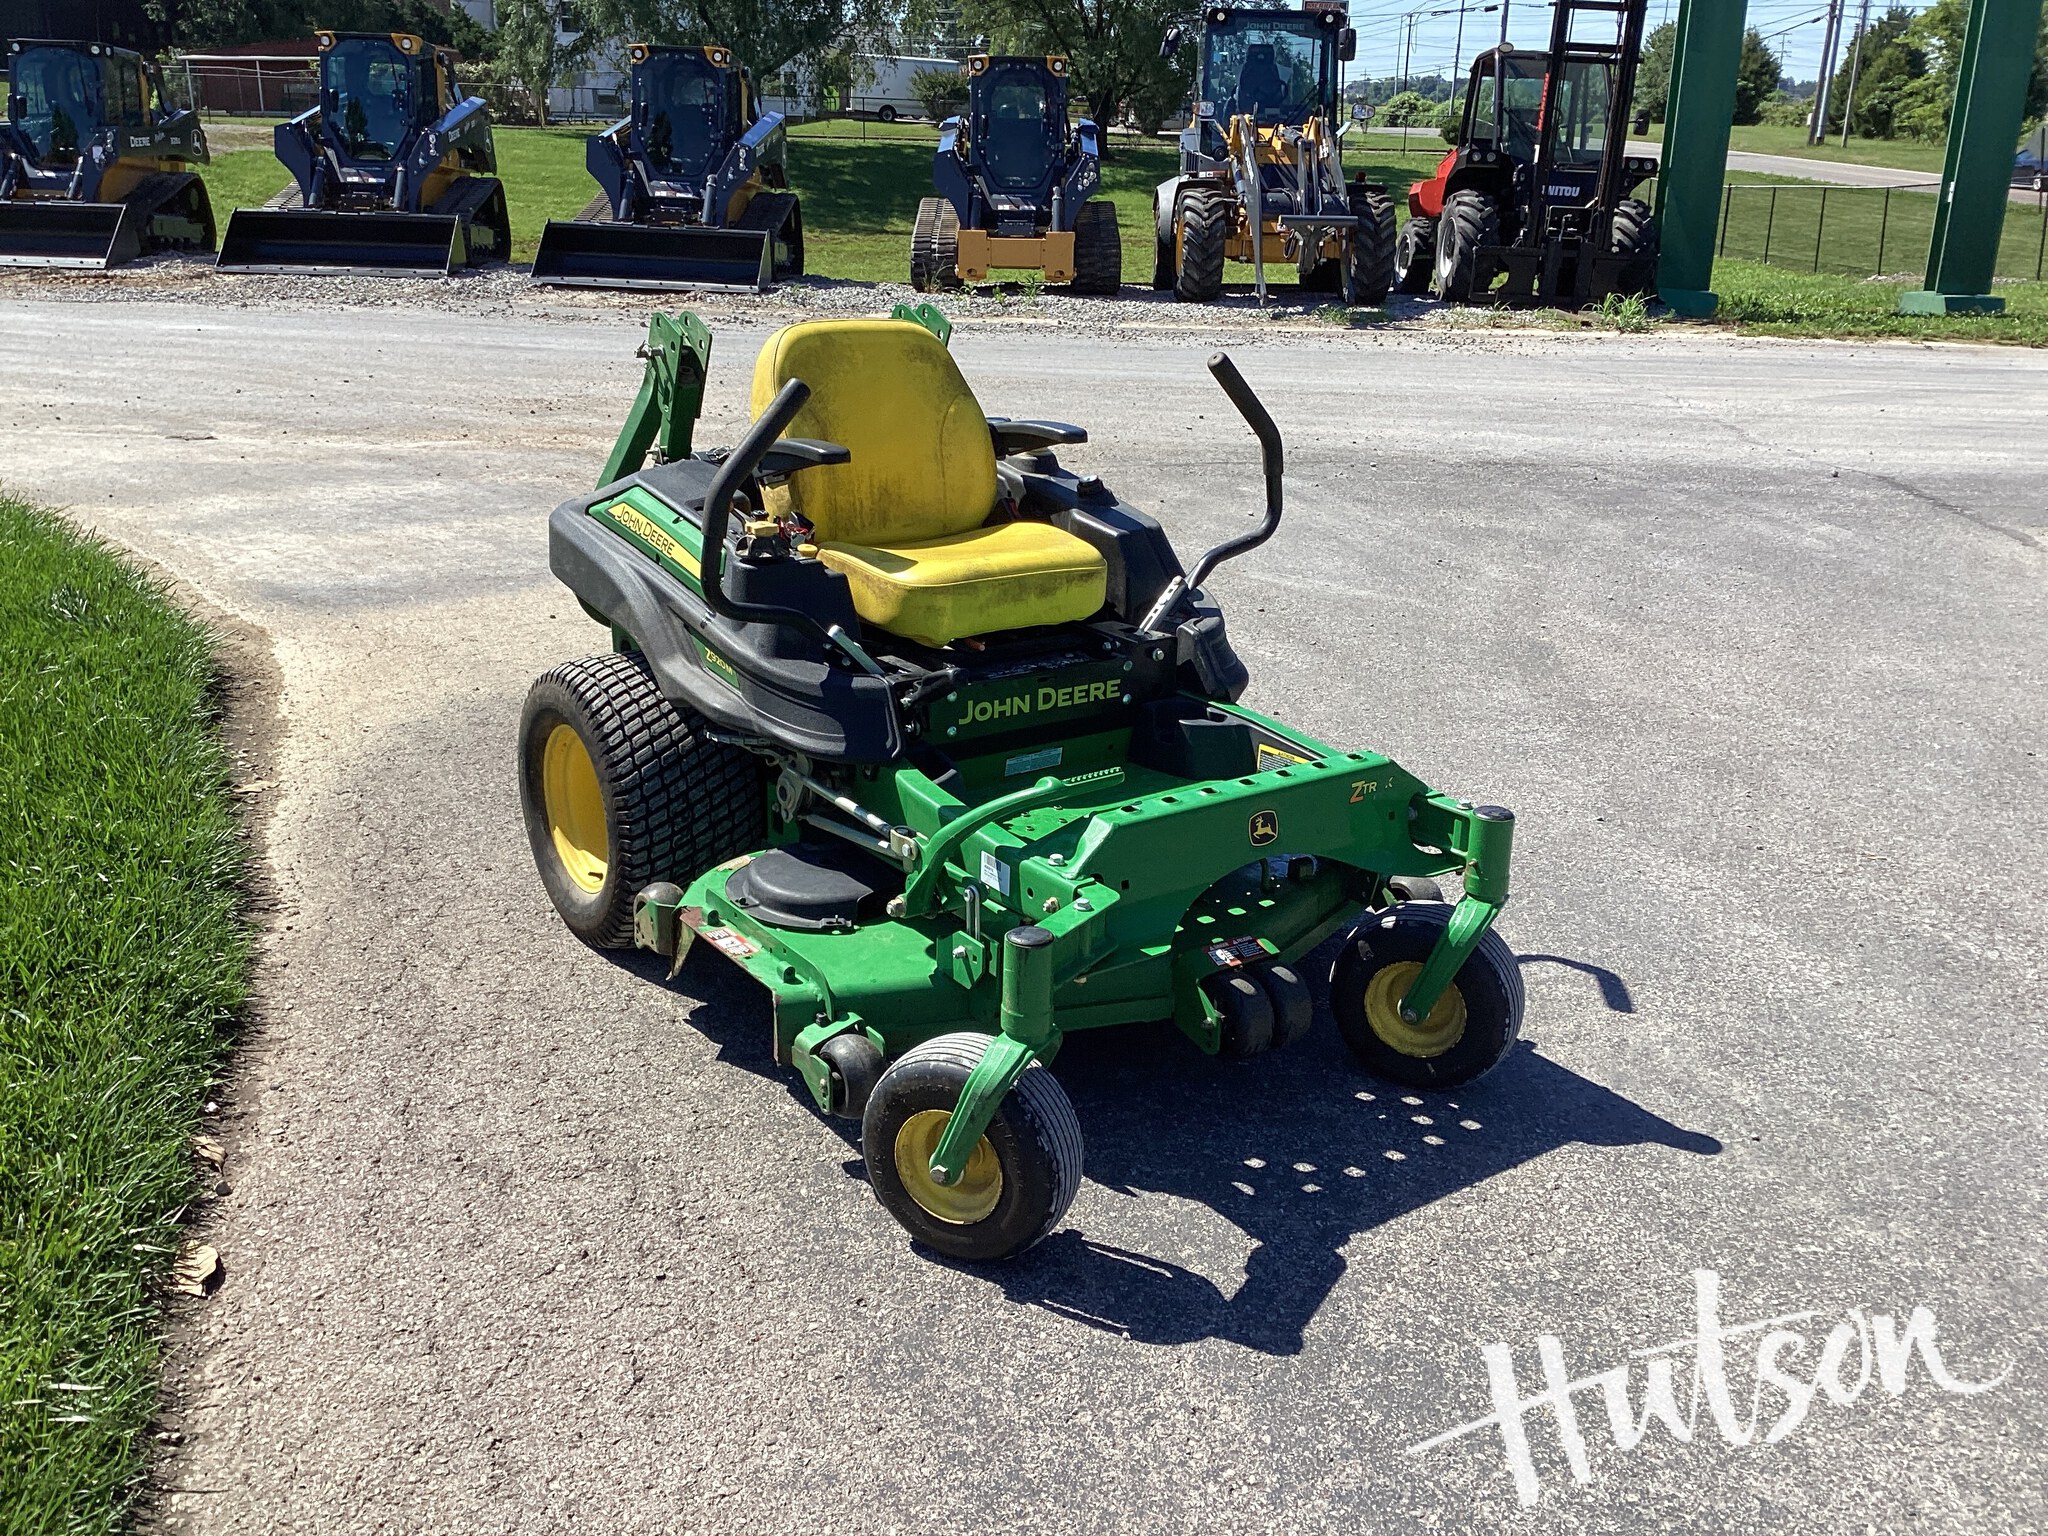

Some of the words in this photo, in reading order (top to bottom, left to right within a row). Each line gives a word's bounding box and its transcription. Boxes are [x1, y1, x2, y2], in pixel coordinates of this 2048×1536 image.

[1244, 22, 1271, 30] JOHN
[1273, 22, 1305, 30] DEERE
[129, 136, 151, 148] DEERE
[1541, 184, 1581, 197] NITOU
[617, 506, 643, 533] JOHN
[643, 522, 675, 556] DEERE
[704, 647, 733, 676] Z920M
[958, 694, 1030, 726] JOHN
[1037, 679, 1122, 711] DEERE
